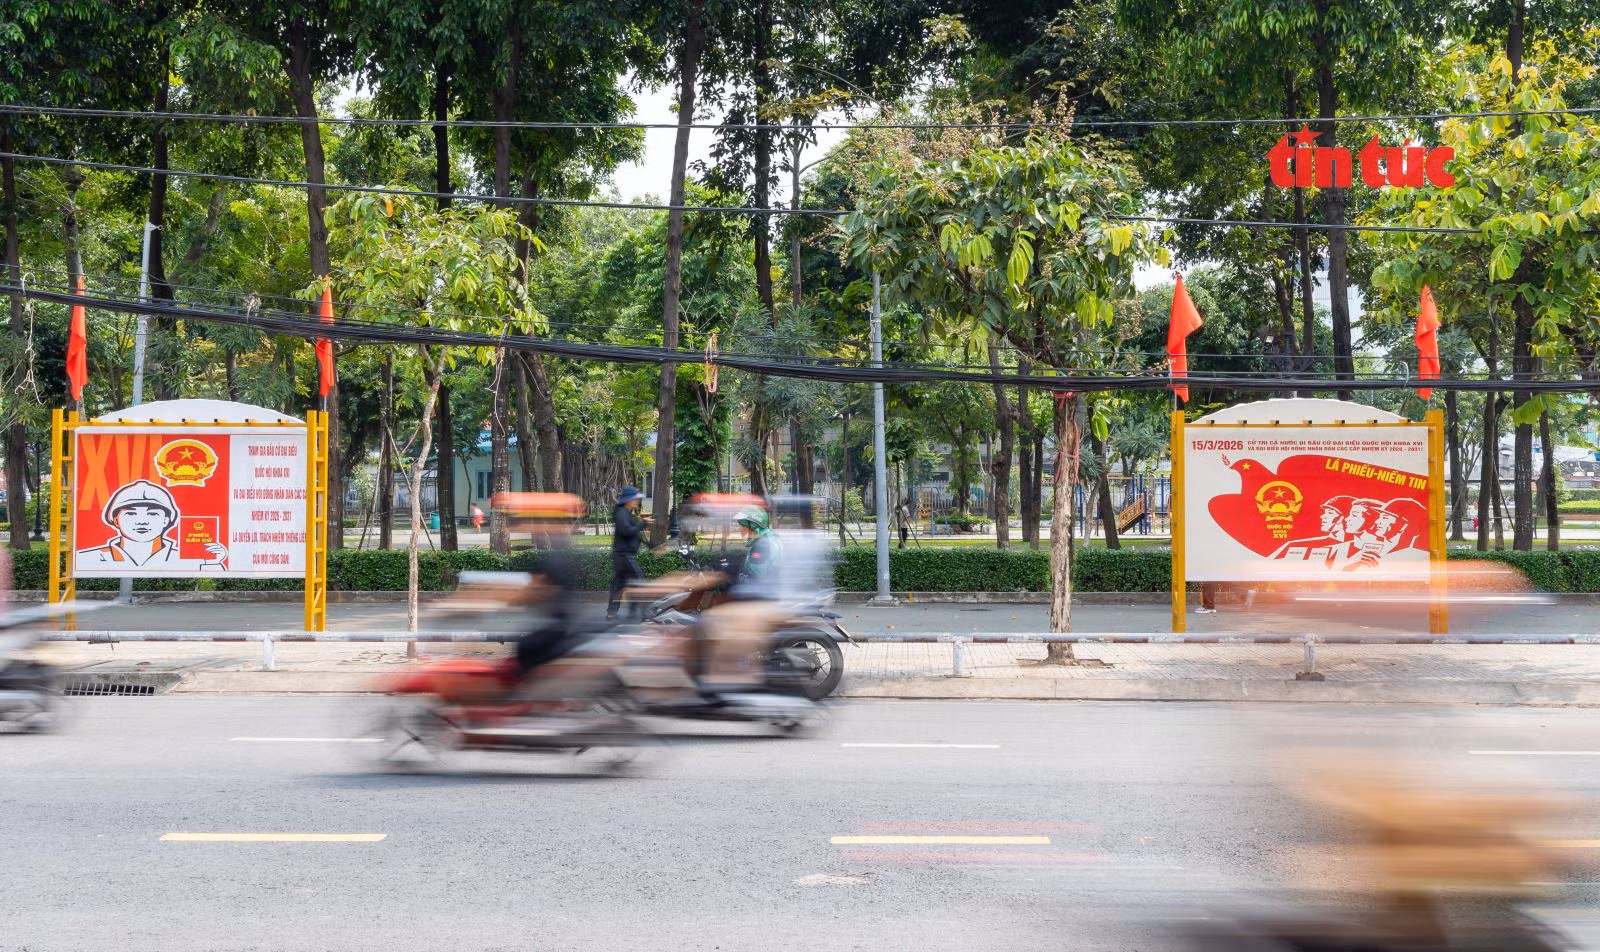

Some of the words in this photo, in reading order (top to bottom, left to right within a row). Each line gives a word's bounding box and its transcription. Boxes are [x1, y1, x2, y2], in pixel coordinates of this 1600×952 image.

[1192, 440, 1243, 450] 15/3/2026
[1325, 458, 1340, 472] LÁ
[1408, 476, 1427, 490] TIN
